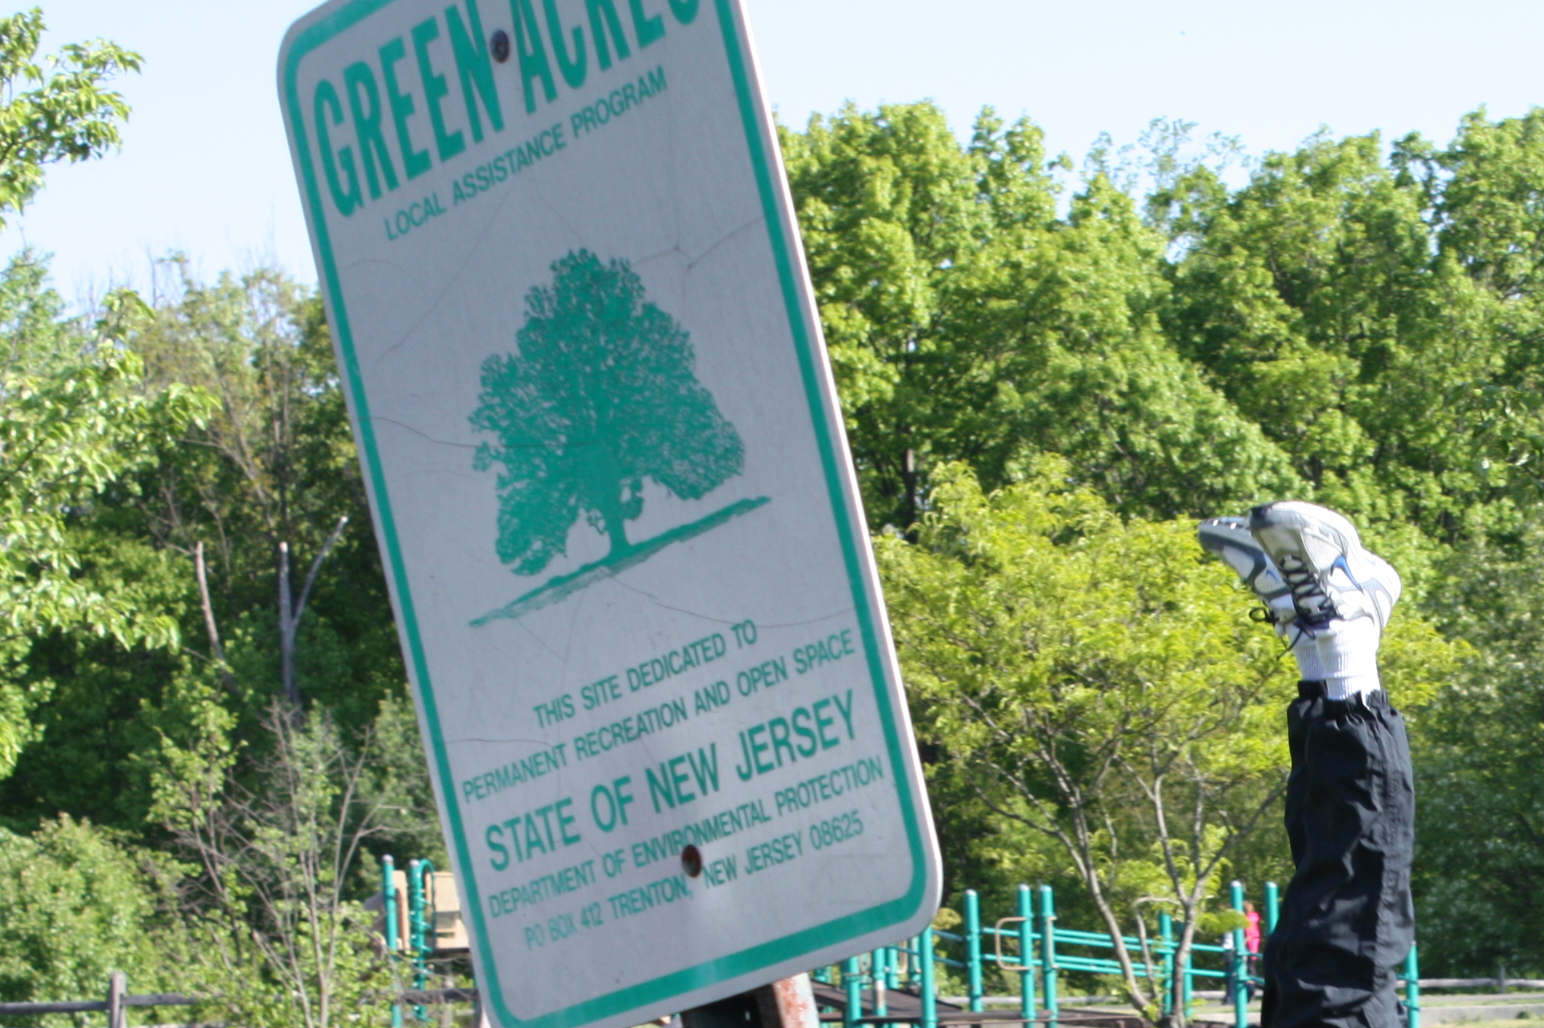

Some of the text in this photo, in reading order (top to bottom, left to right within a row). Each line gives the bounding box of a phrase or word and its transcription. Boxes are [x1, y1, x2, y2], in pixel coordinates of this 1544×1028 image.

[313, 0, 504, 218] GREEN
[383, 64, 668, 241] LOCAL ASSISTANCE PROGRAM
[461, 628, 856, 804] PERMANENT RECREATION AND OPEN SPACE
[532, 619, 758, 729] THIS SITE DEDICATED TO
[485, 689, 857, 872] STATE OF NEW JERSEY
[488, 755, 884, 919] DEPARTMENT OF ENVIRONMENTAL PROTECTION
[524, 809, 864, 950] PO BOX 412 TRENTON, NEW JERSEY 08625
